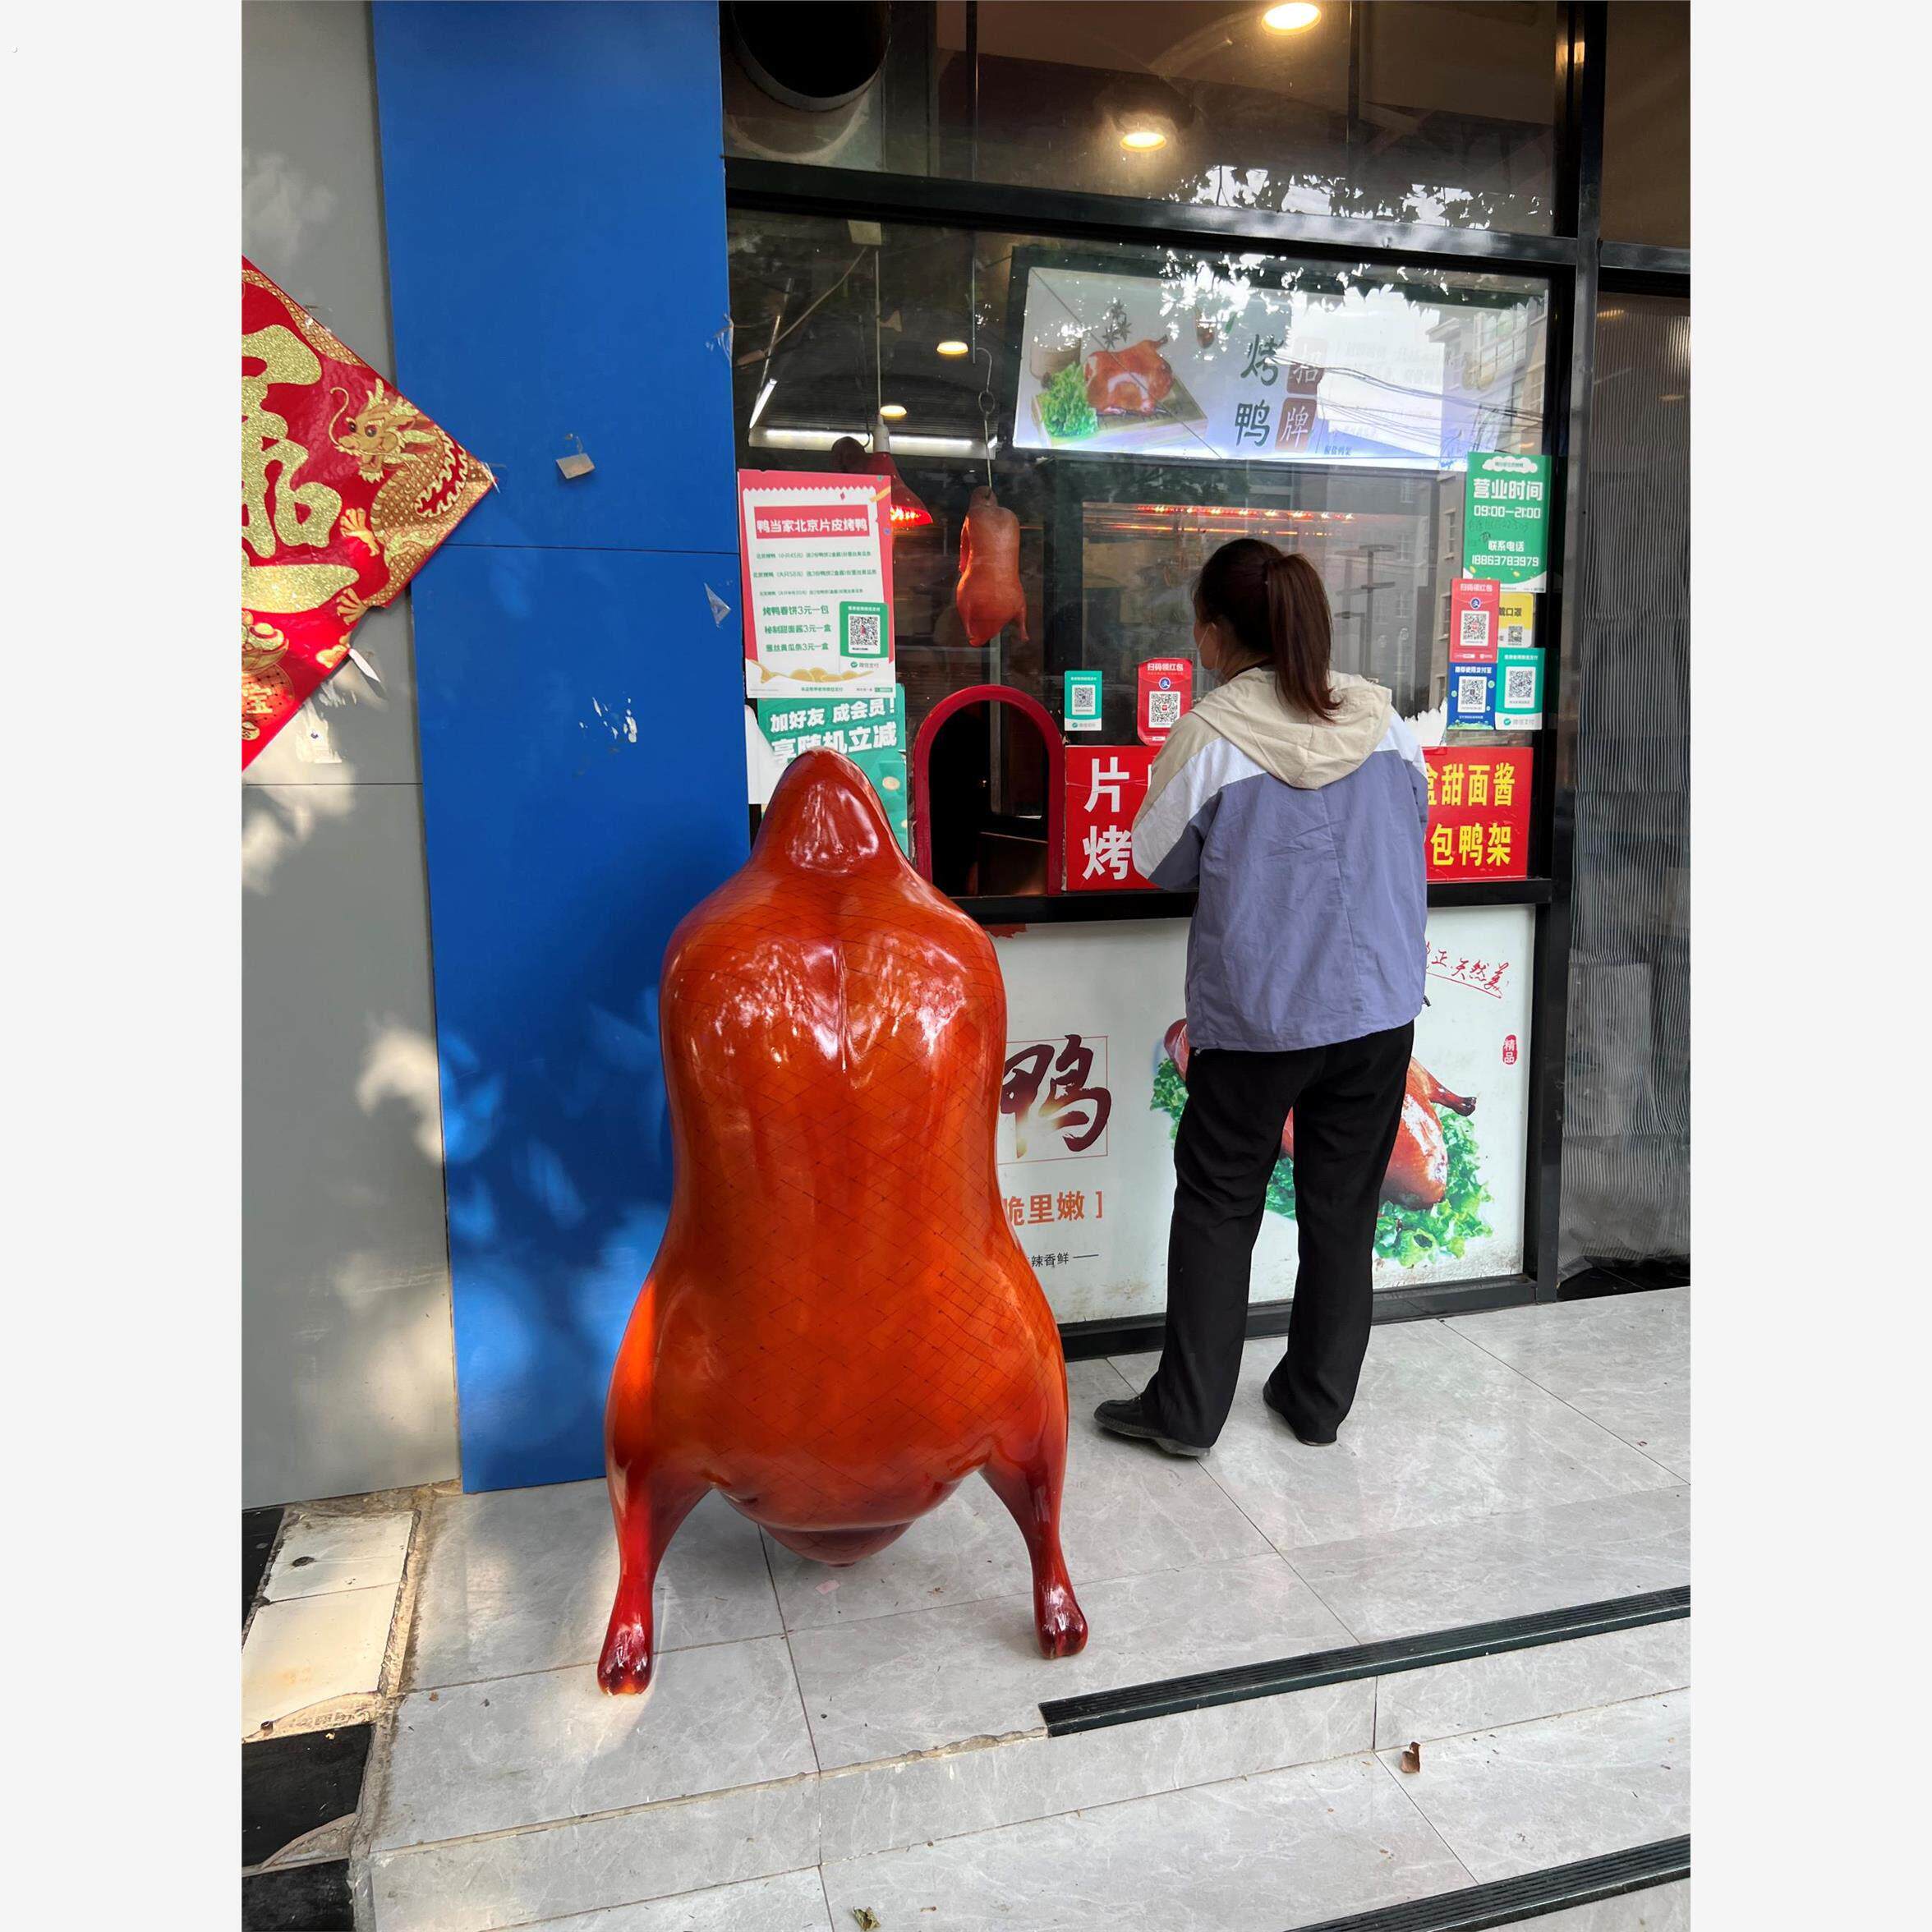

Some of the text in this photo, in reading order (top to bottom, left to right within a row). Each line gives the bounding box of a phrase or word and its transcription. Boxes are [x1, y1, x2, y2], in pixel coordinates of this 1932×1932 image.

[1473, 478, 1543, 501] 营业时间
[756, 518, 868, 533] 鸭当家北京片皮烤鸭
[1488, 540, 1525, 552] 联系电话
[1471, 554, 1539, 567] 18863783979
[1147, 663, 1183, 671] 扫码领红包
[770, 707, 825, 733] 加好友
[1082, 825, 1132, 881] 烤
[1430, 822, 1511, 867] 包鸭架
[1504, 1038, 1516, 1064] 精品
[1000, 1034, 1111, 1158] 鸭
